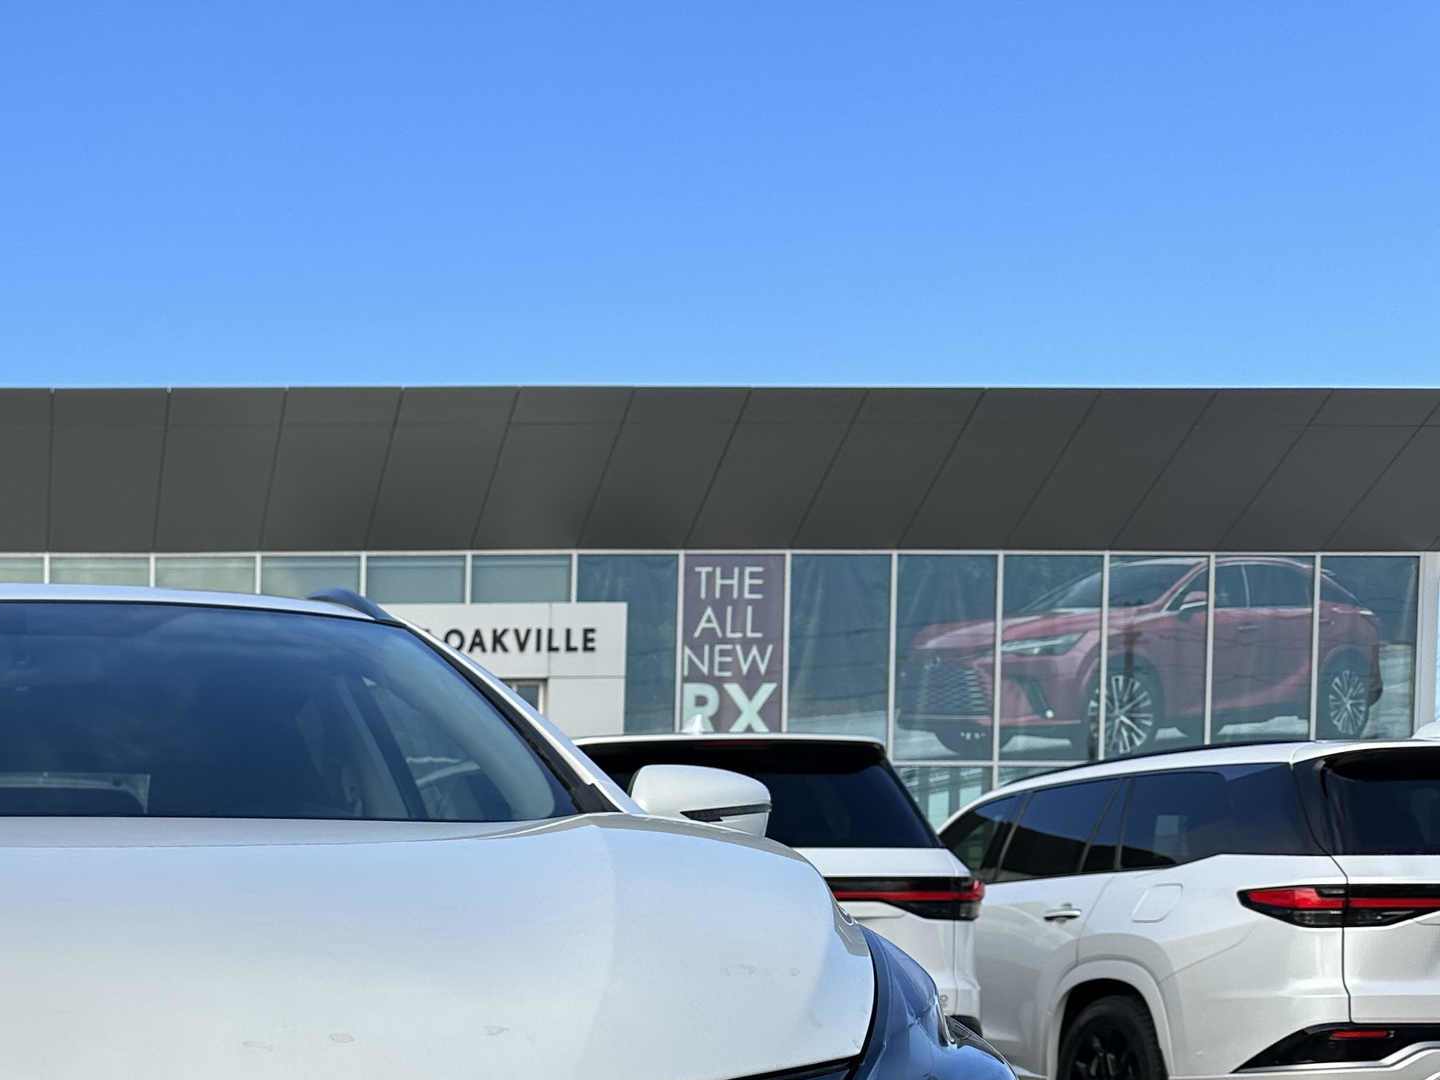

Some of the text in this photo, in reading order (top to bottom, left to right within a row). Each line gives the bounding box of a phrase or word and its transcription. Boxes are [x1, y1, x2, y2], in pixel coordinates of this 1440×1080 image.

[695, 566, 764, 599] THE
[693, 605, 763, 638] ALL
[444, 628, 596, 653] OAKVILLE
[684, 644, 773, 677] NEW
[682, 682, 777, 732] RX
